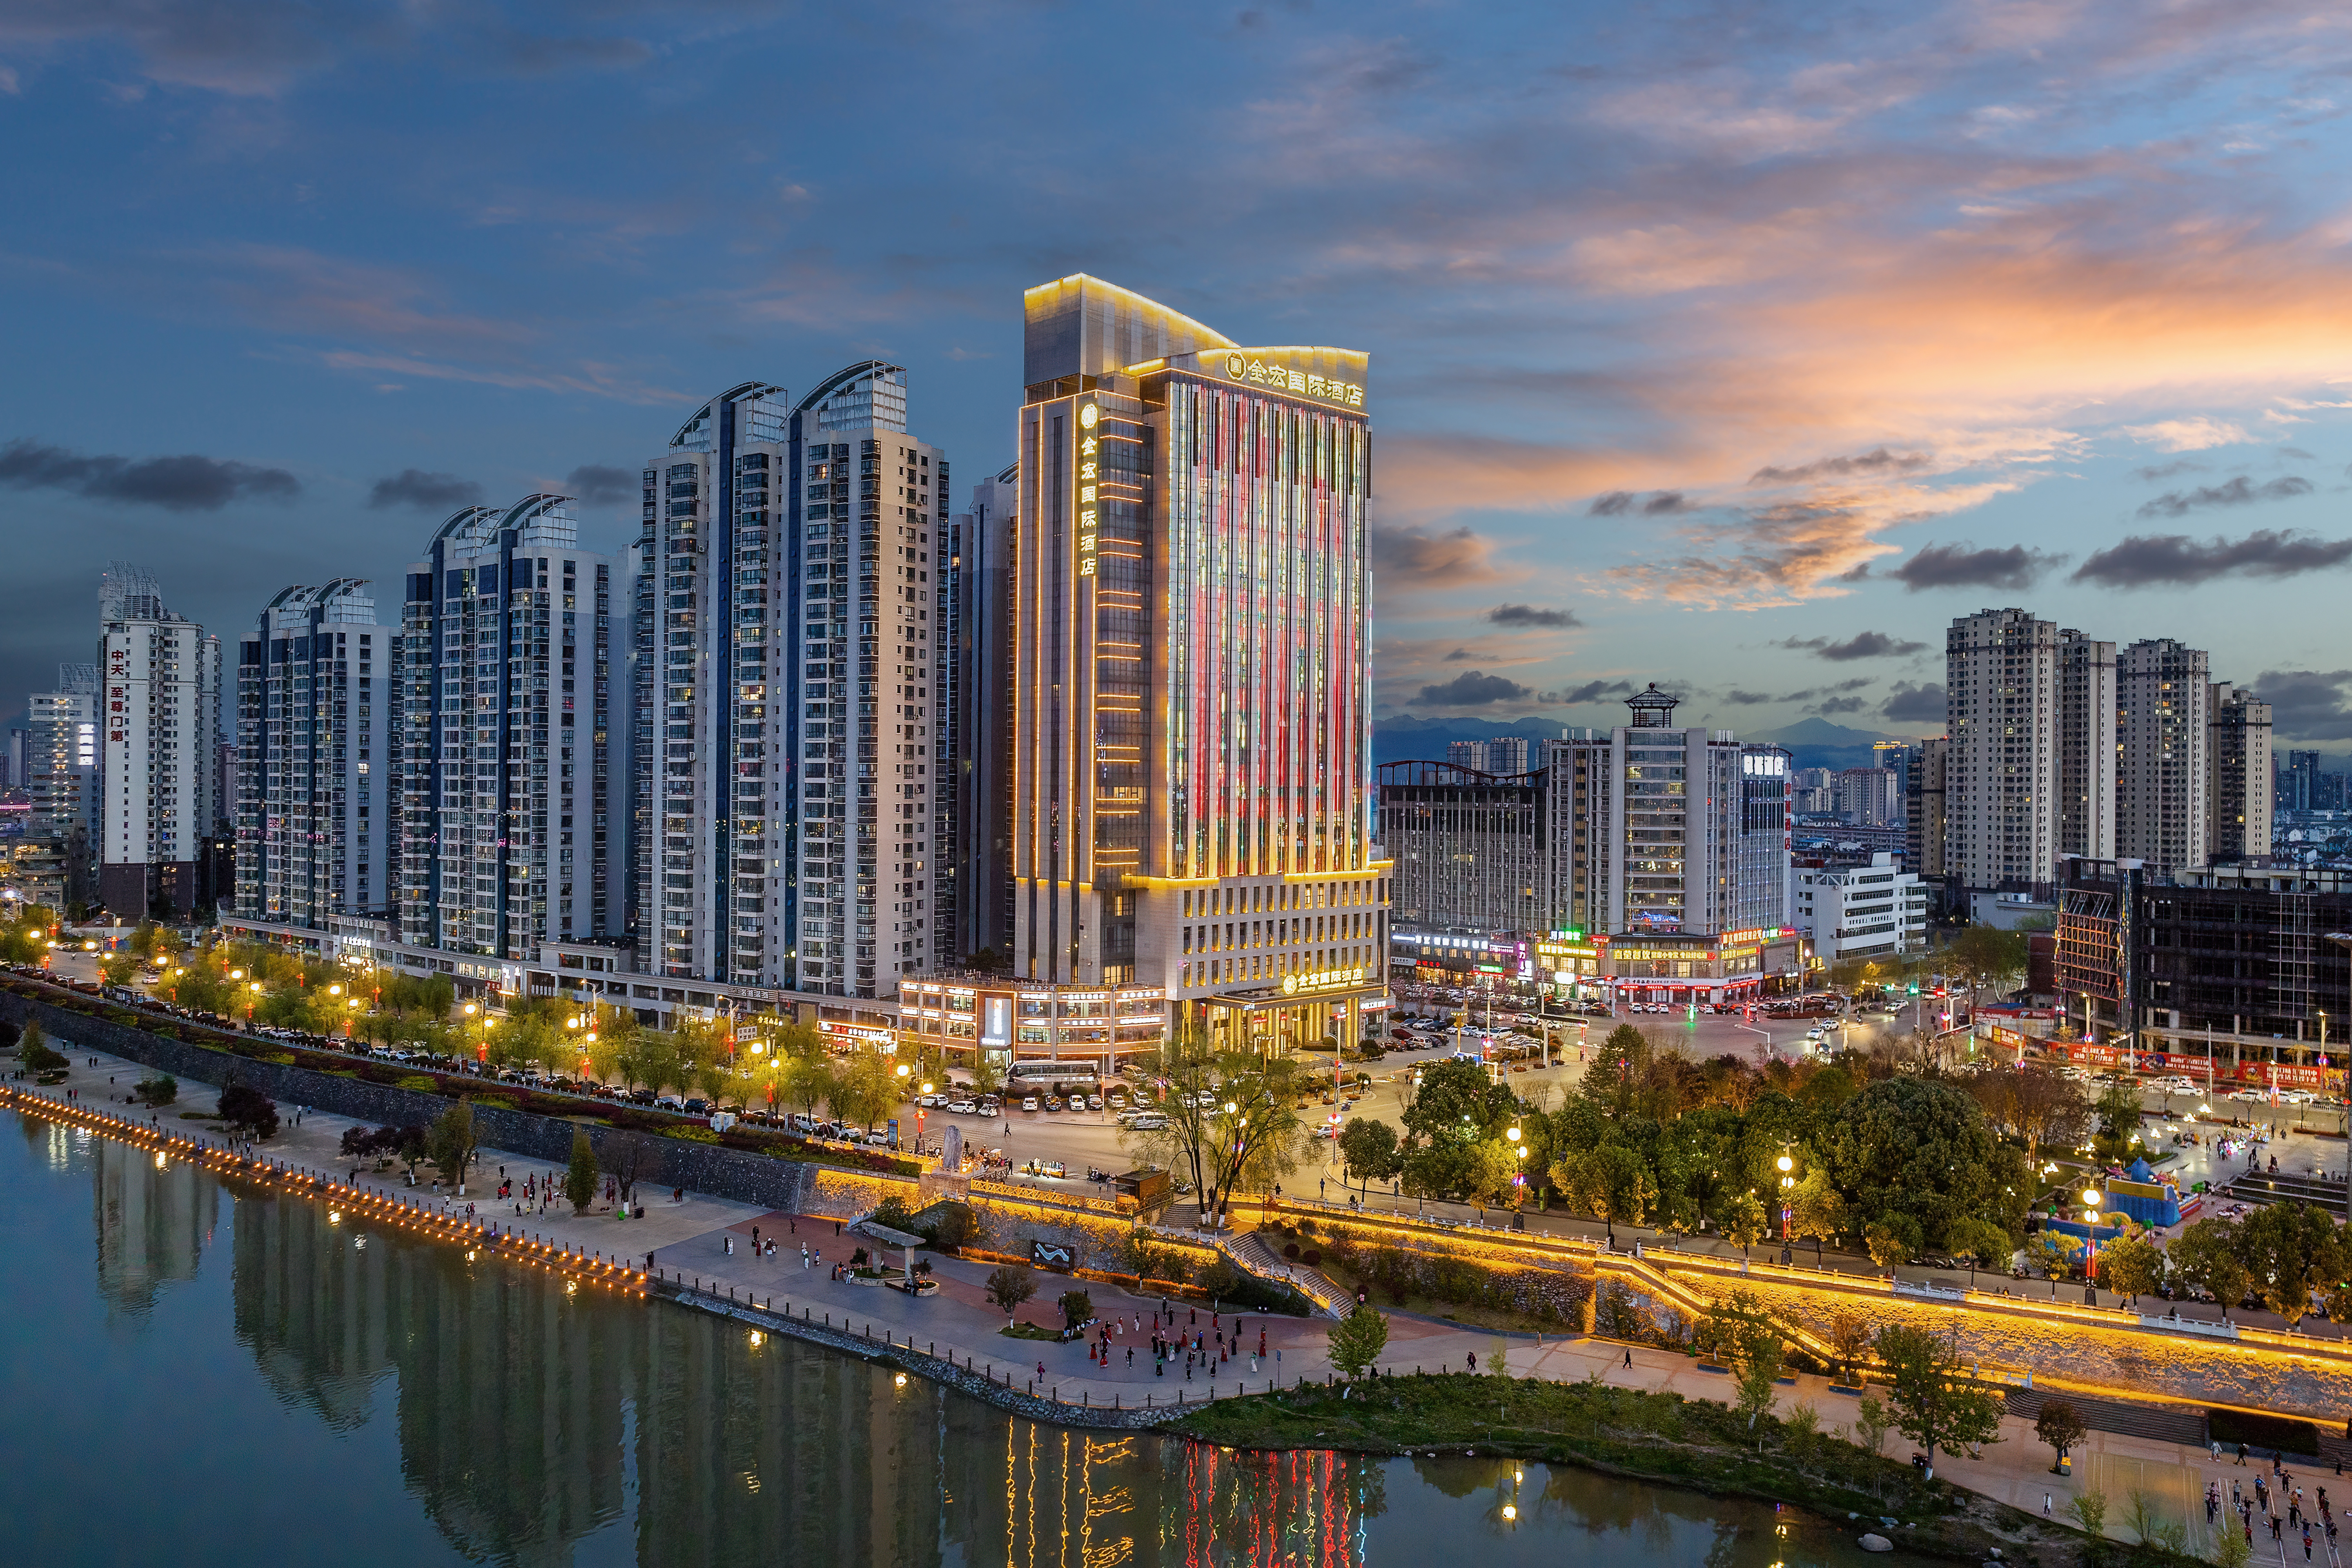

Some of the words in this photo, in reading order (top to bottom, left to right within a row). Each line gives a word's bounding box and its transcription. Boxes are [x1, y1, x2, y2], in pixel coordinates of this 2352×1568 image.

[1247, 359, 1363, 406] 金宏国际酒店
[1081, 436, 1097, 576] 金宏国际酒店
[110, 650, 124, 742] 中天至尊门第
[1297, 968, 1363, 987] 金宏国际酒店
